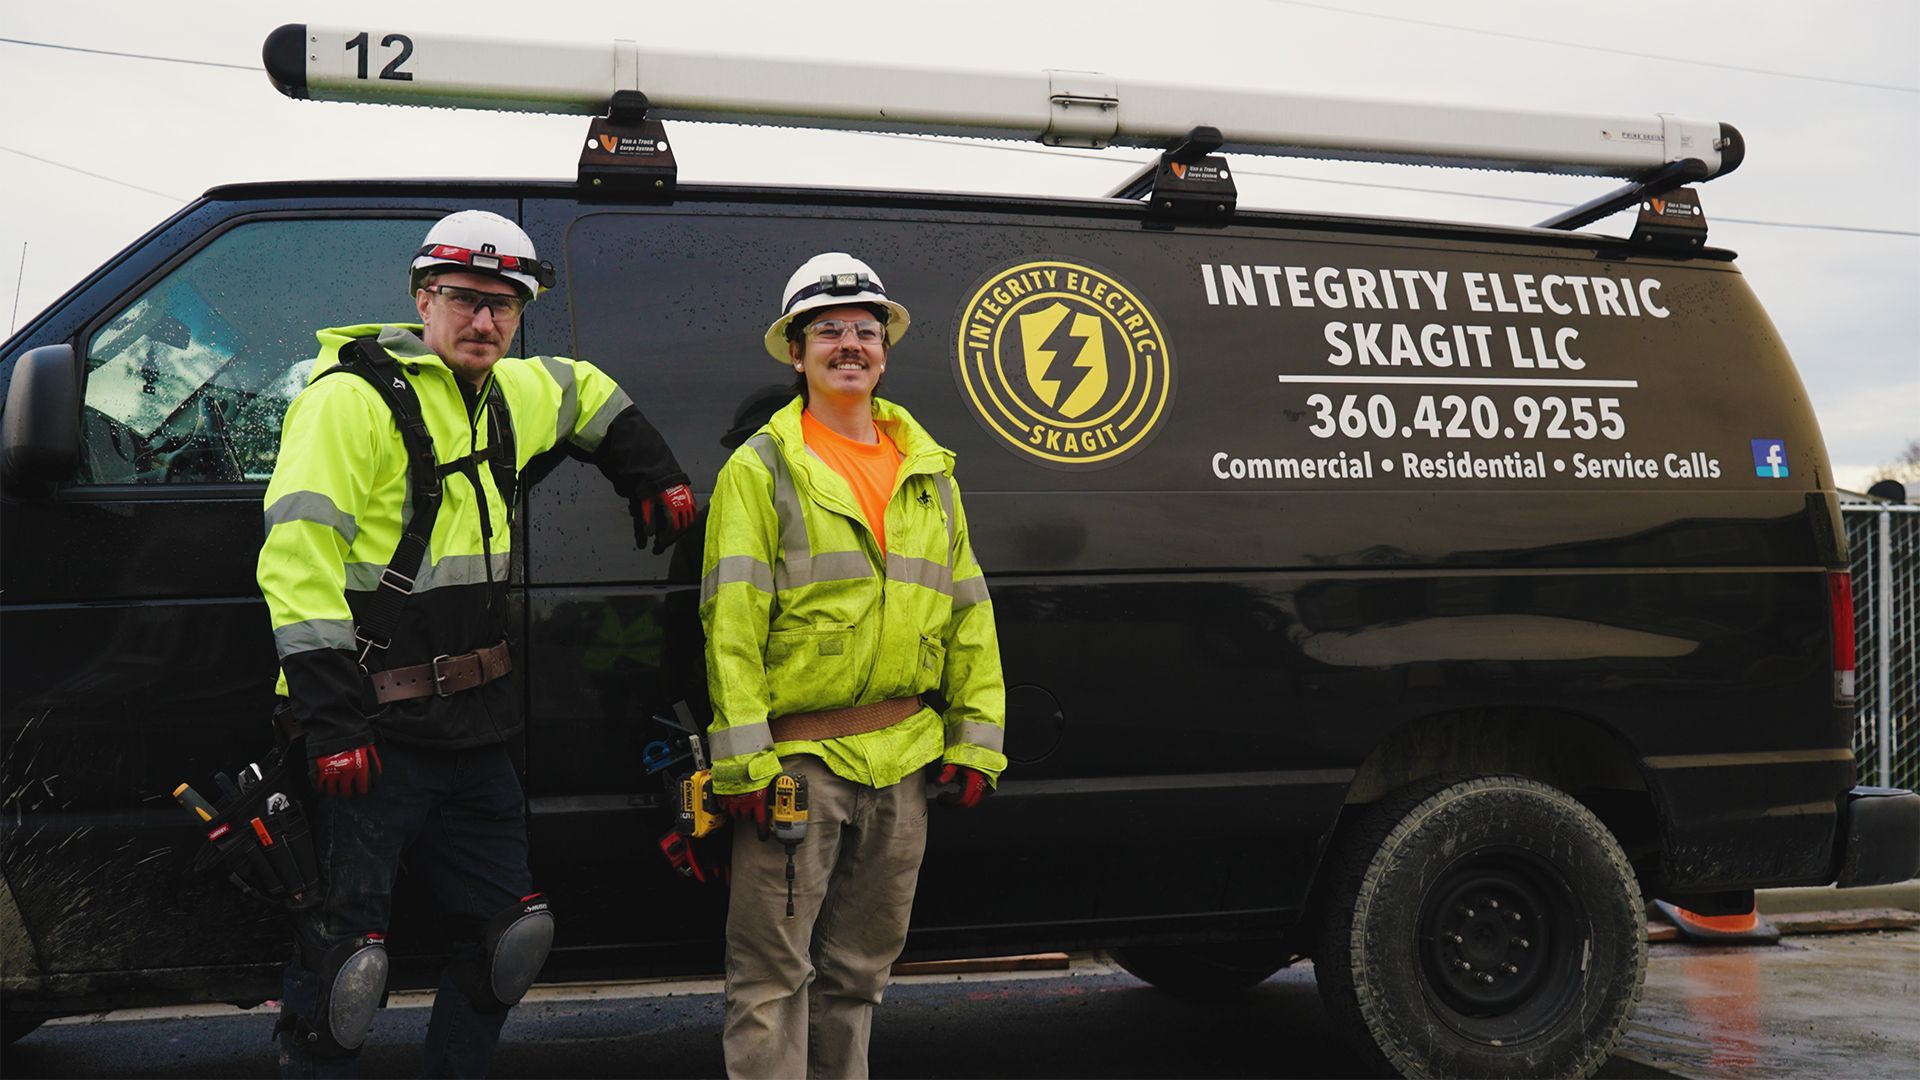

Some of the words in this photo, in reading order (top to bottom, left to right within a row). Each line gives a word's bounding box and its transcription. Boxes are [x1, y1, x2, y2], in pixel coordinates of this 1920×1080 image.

[345, 32, 413, 81] 12
[968, 270, 1057, 349] INTEGRITY
[1066, 271, 1157, 353] ELECTRIC
[1200, 263, 1448, 311] INTEGRITY
[1462, 271, 1671, 319] ELECTRIC
[1324, 321, 1493, 369] SKAGIT
[1505, 326, 1587, 371] LLC
[1029, 423, 1119, 453] SKAGIT
[1306, 393, 1626, 440] 360.420.9255
[1211, 450, 1373, 480] Commercial
[1402, 450, 1546, 480] Residential
[1572, 451, 1659, 480] Service
[1663, 452, 1721, 480] Calls
